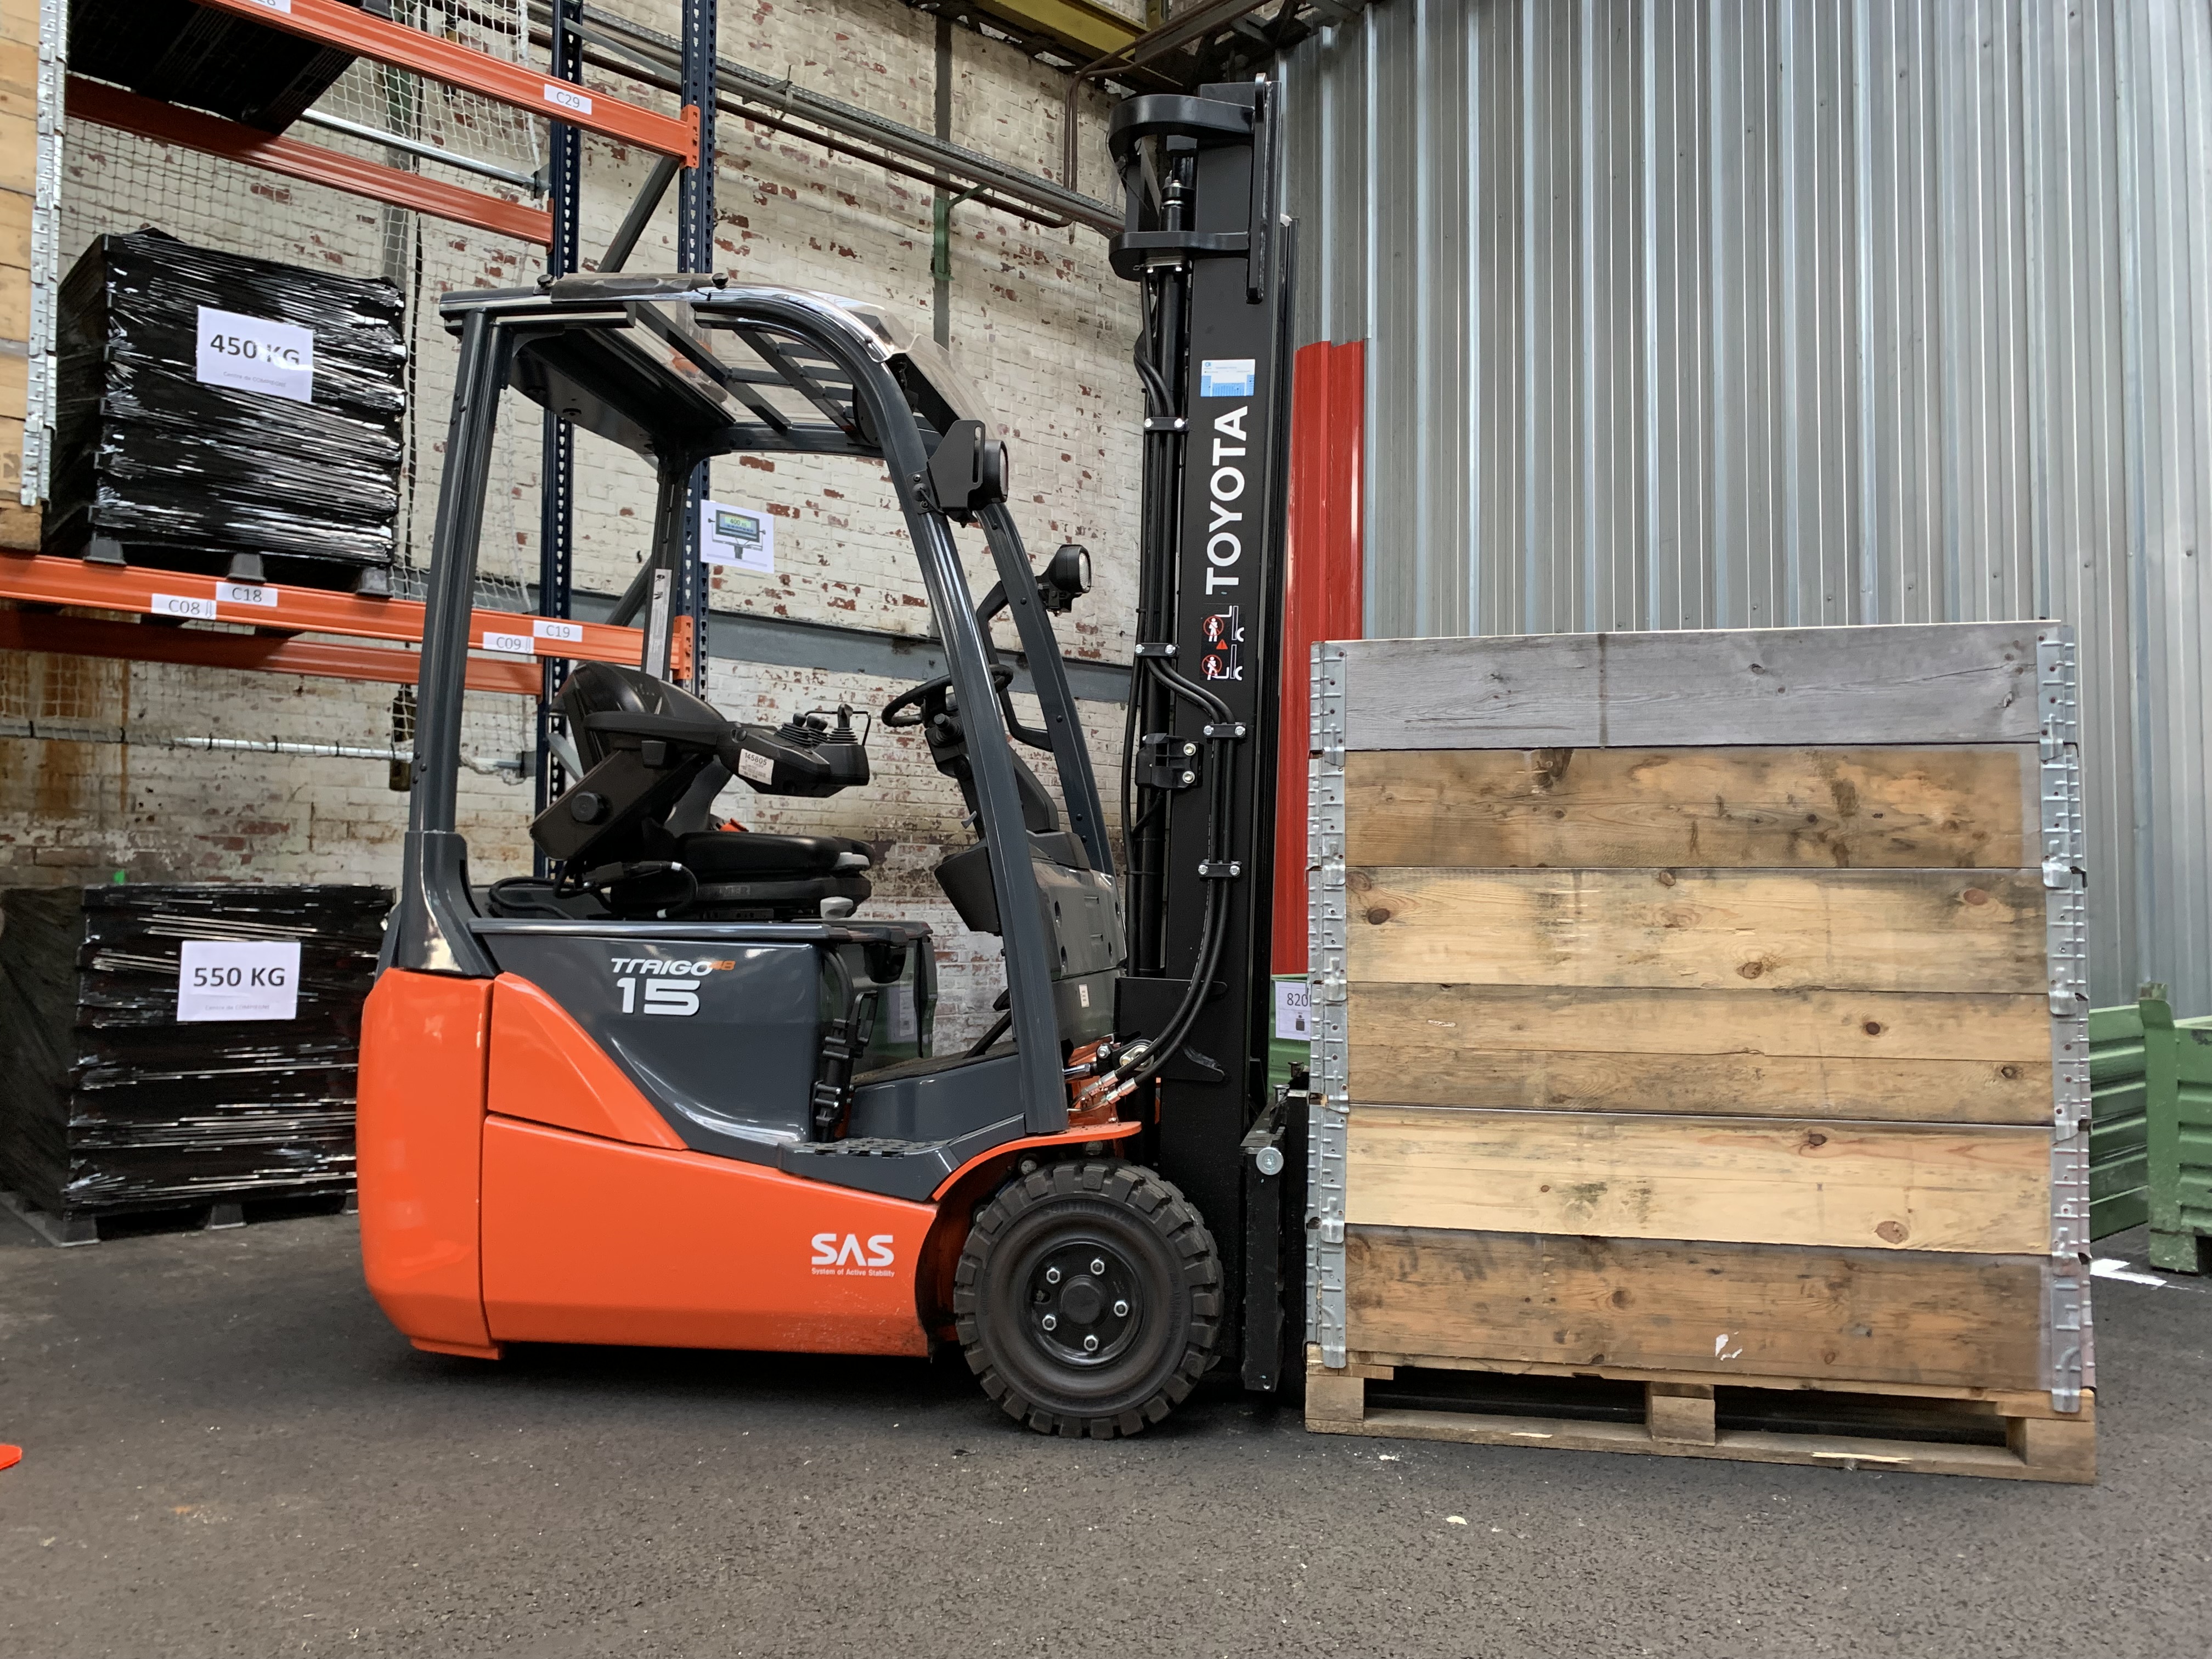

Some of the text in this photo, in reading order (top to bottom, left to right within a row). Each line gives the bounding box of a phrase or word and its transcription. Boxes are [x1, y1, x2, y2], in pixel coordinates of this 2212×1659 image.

[556, 92, 580, 108] C29
[210, 334, 257, 359] 450
[1206, 406, 1248, 595] TOYOTA
[232, 587, 262, 602] C18
[168, 599, 200, 615] C08
[546, 625, 570, 638] C19
[496, 636, 521, 650] C09
[745, 752, 767, 766] 145805
[194, 967, 285, 986] 550 KG
[617, 977, 701, 1016] 15
[1287, 992, 1311, 1007] 820
[811, 1233, 894, 1267] SAS
[868, 1268, 895, 1278] Stability
